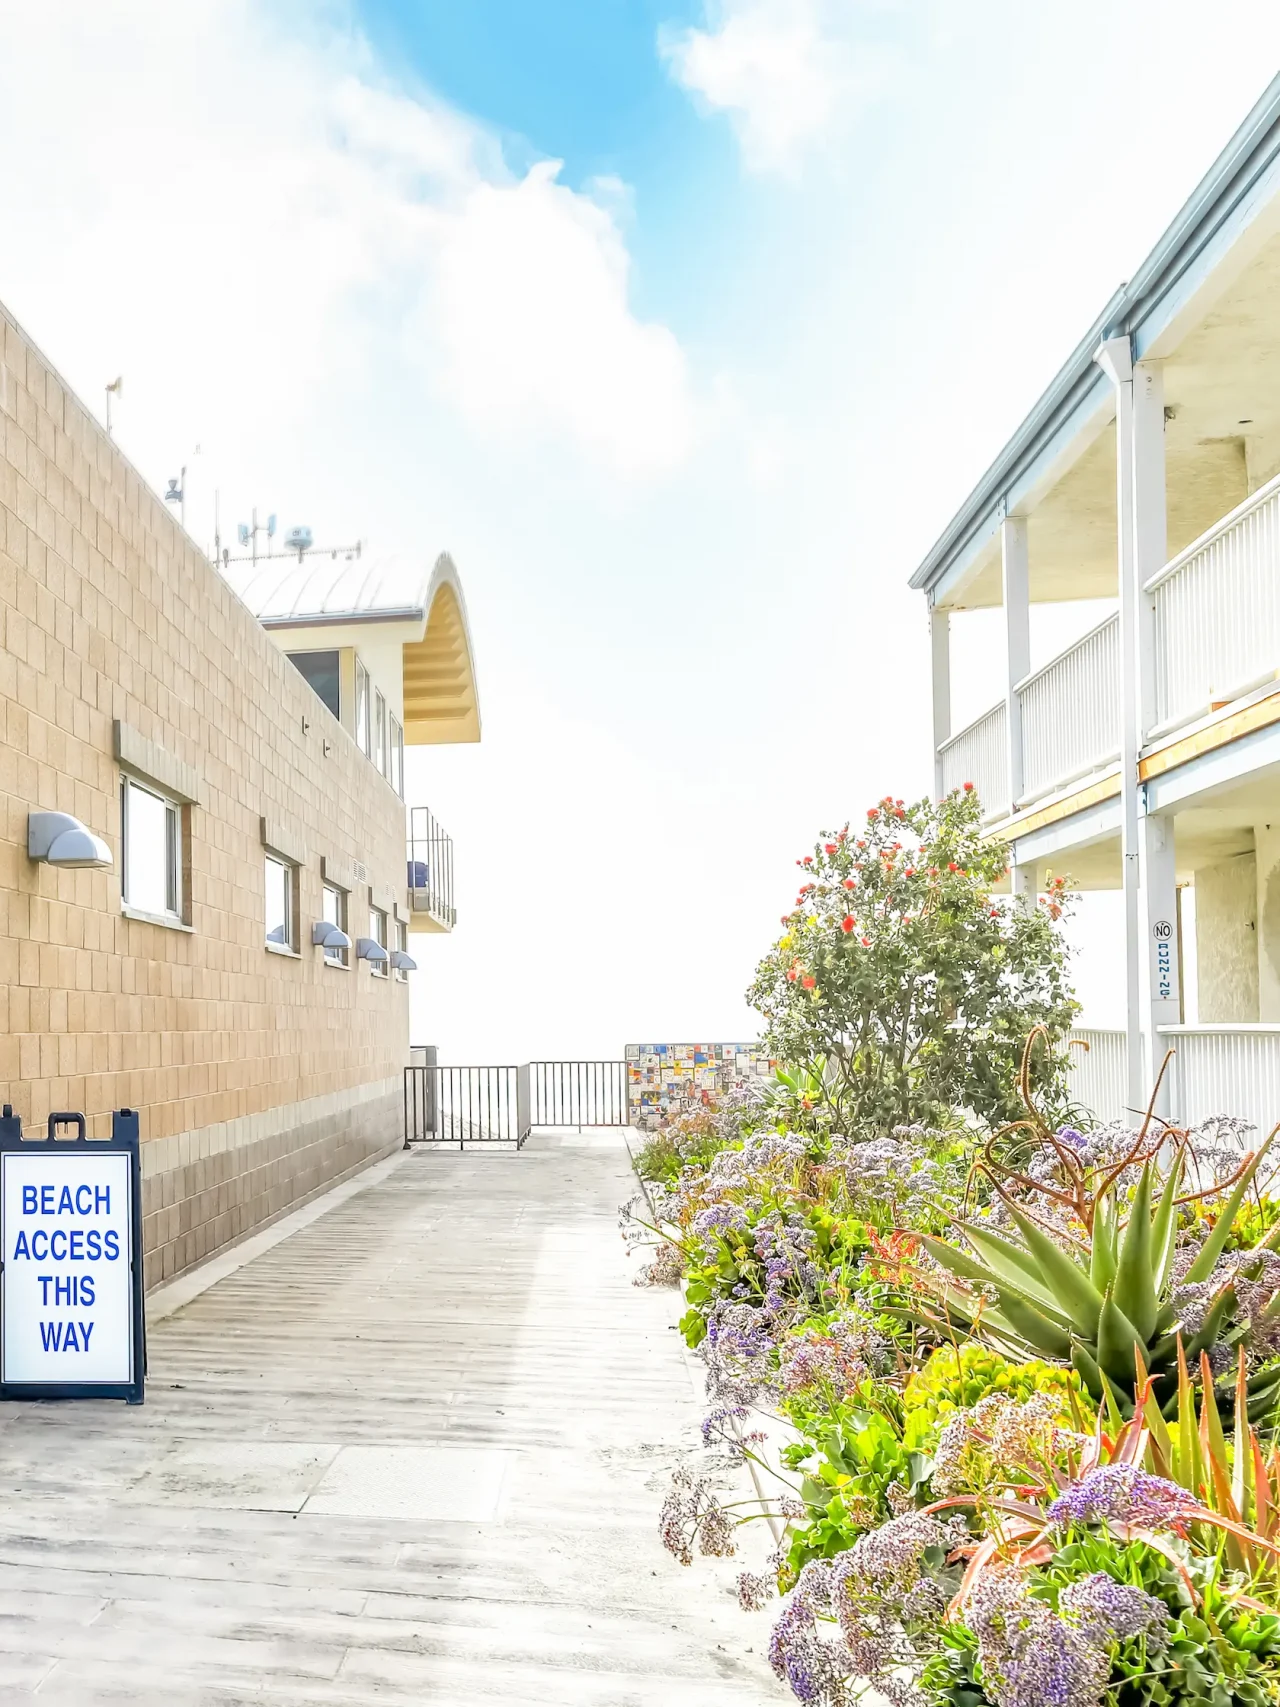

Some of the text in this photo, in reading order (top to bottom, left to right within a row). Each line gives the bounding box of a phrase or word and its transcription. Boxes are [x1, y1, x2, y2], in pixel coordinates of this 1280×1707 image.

[1156, 925, 1171, 937] NO
[1158, 943, 1170, 996] RUNNING
[22, 1185, 111, 1215] BEACH
[13, 1230, 120, 1261] ACCESS
[38, 1275, 95, 1306] THIS
[39, 1322, 95, 1352] WAY
